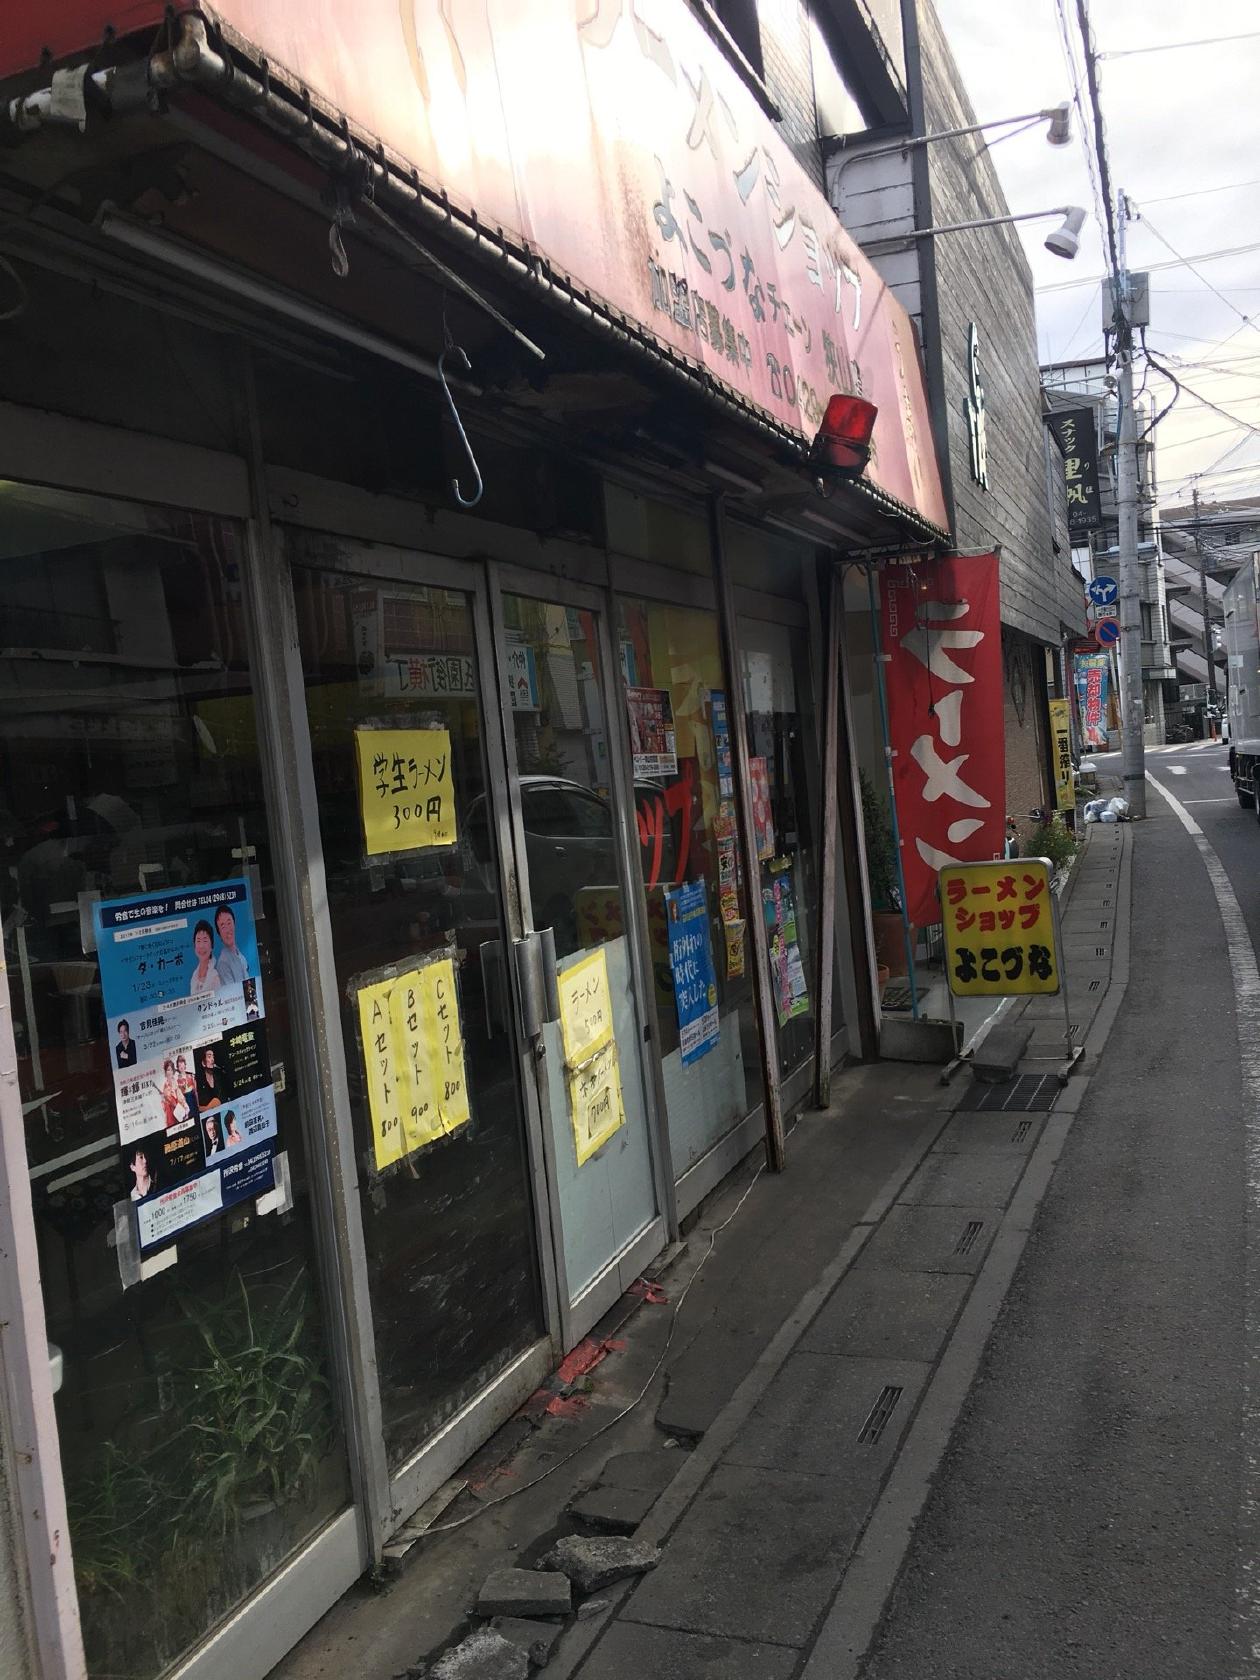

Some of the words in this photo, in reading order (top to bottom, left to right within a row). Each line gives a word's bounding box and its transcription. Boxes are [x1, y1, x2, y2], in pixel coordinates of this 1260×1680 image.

[1060, 418, 1077, 454] スナック
[900, 597, 991, 873] ラーメン
[373, 752, 446, 798] 学生ラーメン
[1056, 729, 1071, 785] 一番搾り
[393, 796, 442, 830] 300円
[946, 875, 1045, 903] ラーメン
[954, 903, 1042, 933] ショップ
[954, 943, 1054, 984] よこづな
[570, 978, 600, 1016] ラーメン
[371, 1000, 392, 1105] Aセット
[406, 988, 422, 1086] Bセット
[436, 979, 452, 1066] Cセット
[444, 1080, 460, 1101] 800
[381, 1115, 398, 1138] 800
[411, 1102, 429, 1118] 900
